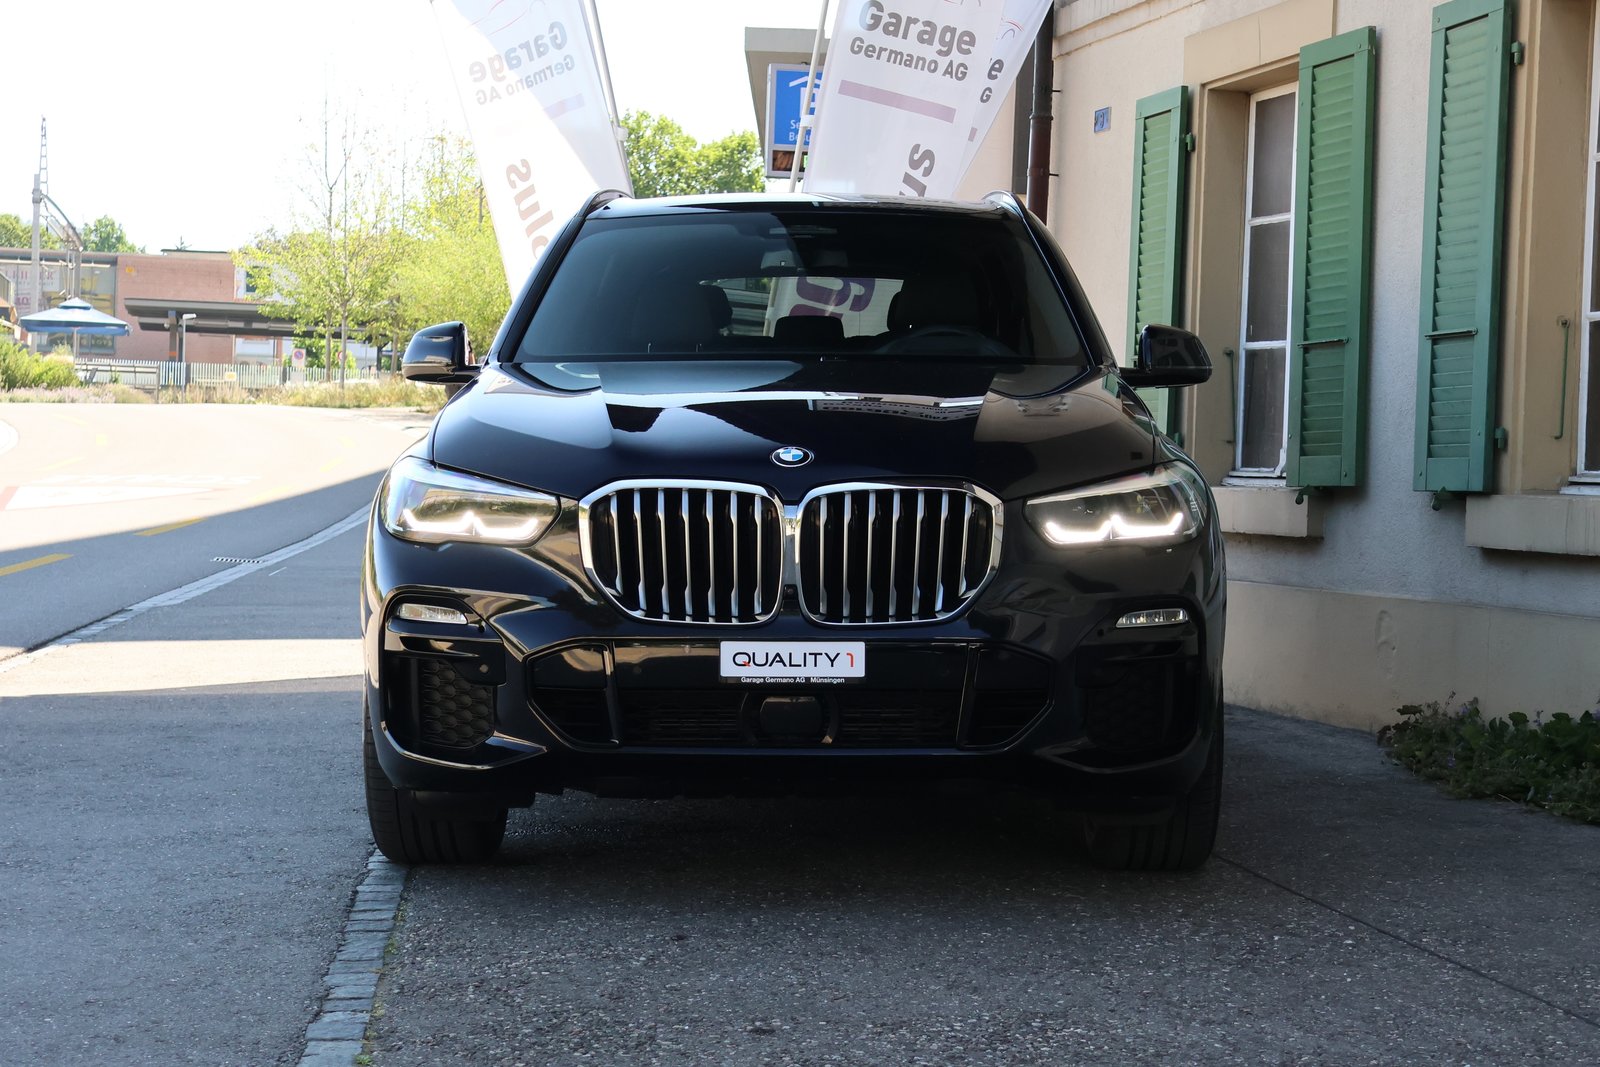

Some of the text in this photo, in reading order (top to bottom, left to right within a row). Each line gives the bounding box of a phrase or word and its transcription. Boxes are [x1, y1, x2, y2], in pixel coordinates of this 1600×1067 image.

[858, 0, 977, 57] Garage
[850, 36, 939, 74] Germano
[942, 59, 969, 82] AG
[732, 652, 854, 667] QUALITY 1
[741, 676, 764, 684] Garage
[811, 676, 845, 684] Münsingen
